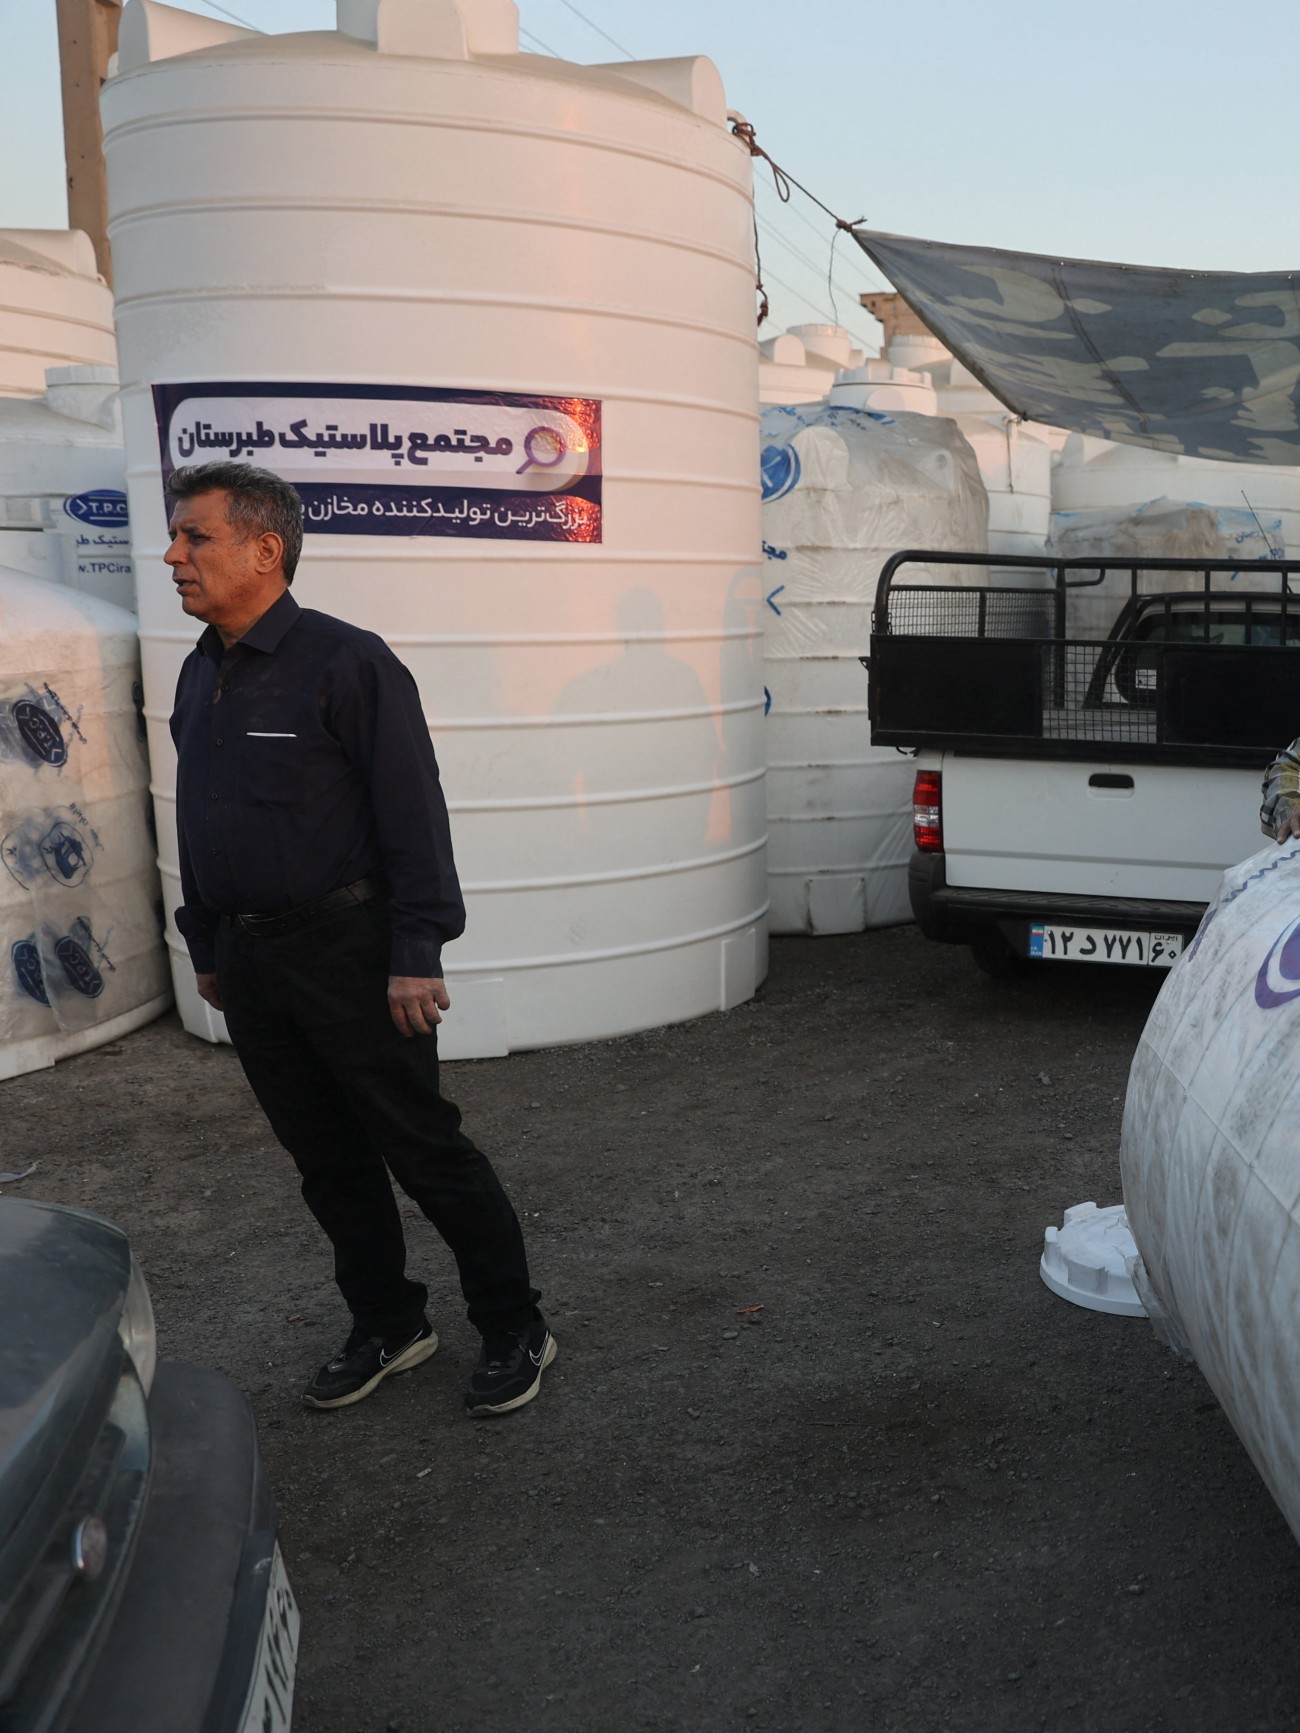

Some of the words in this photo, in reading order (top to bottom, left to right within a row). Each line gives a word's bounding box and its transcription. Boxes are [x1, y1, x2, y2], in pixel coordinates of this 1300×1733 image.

[177, 420, 275, 458] طبرستان
[278, 418, 404, 466] پلاستیک
[406, 428, 513, 466] مجتمع
[307, 495, 367, 521] مخازن
[93, 535, 130, 548] ستیک
